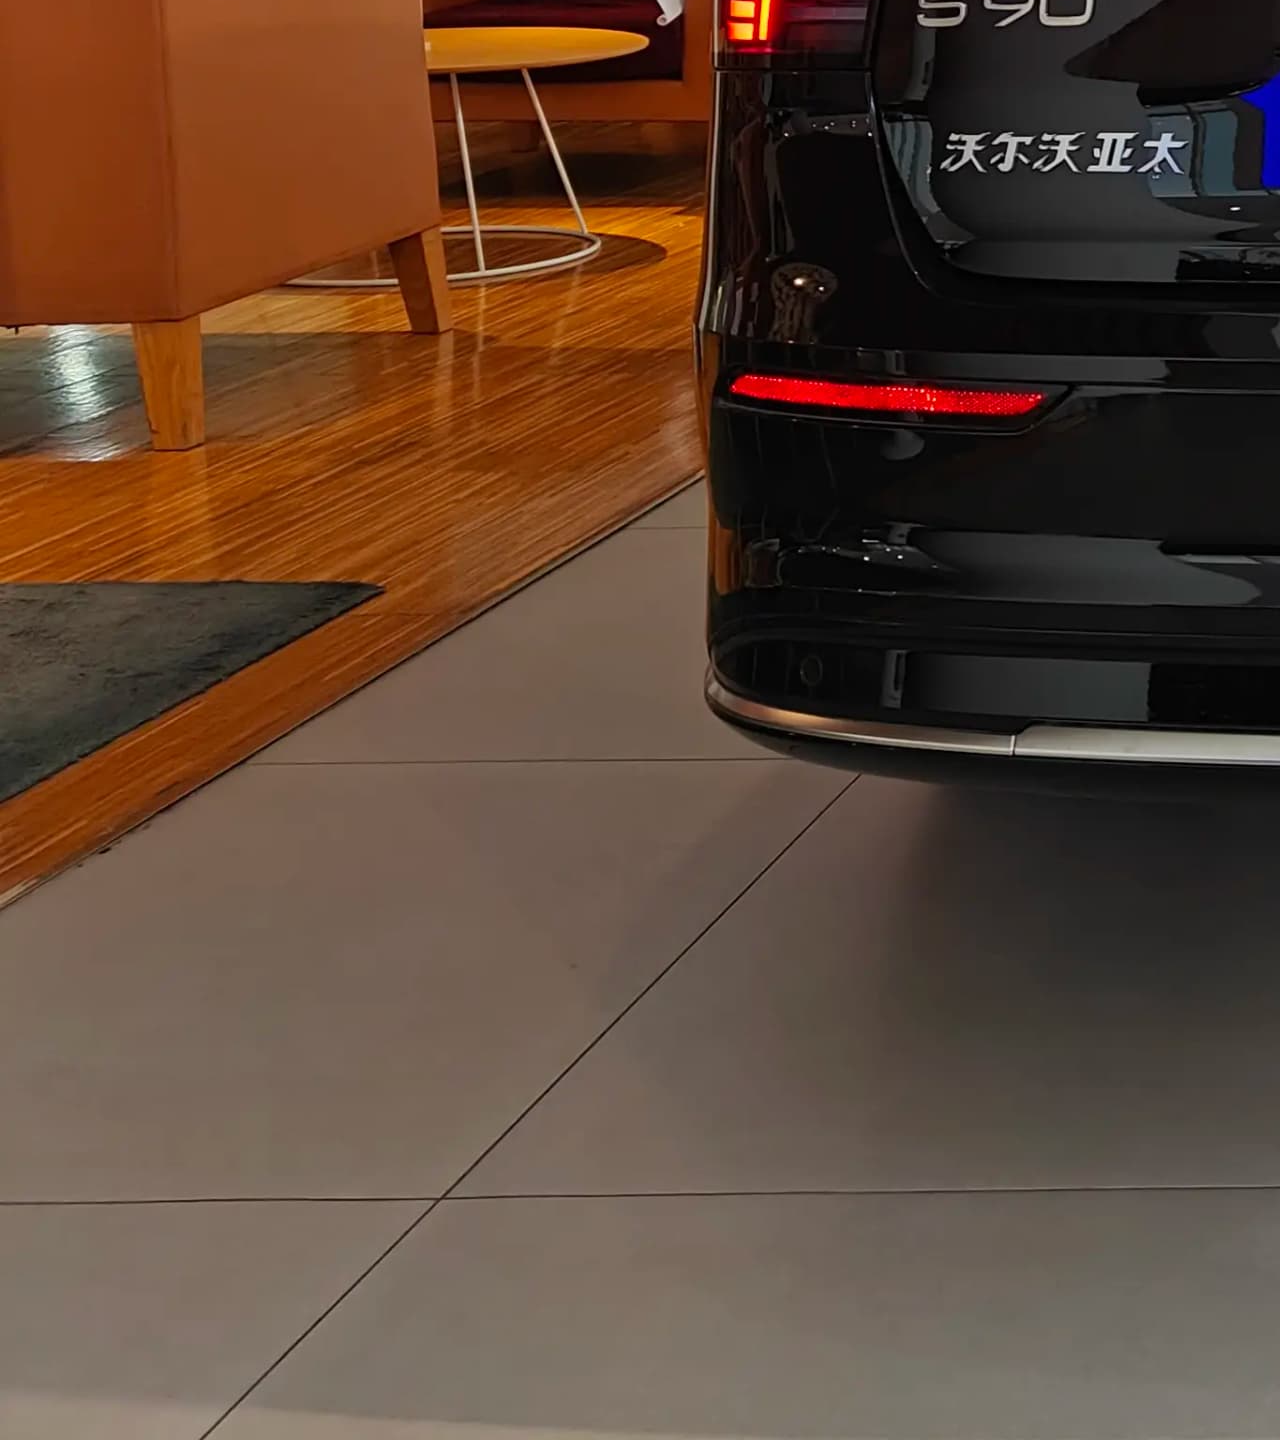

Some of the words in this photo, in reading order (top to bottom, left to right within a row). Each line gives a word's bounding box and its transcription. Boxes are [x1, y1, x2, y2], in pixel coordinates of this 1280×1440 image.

[940, 131, 1188, 175] 沃尔沃亚太
